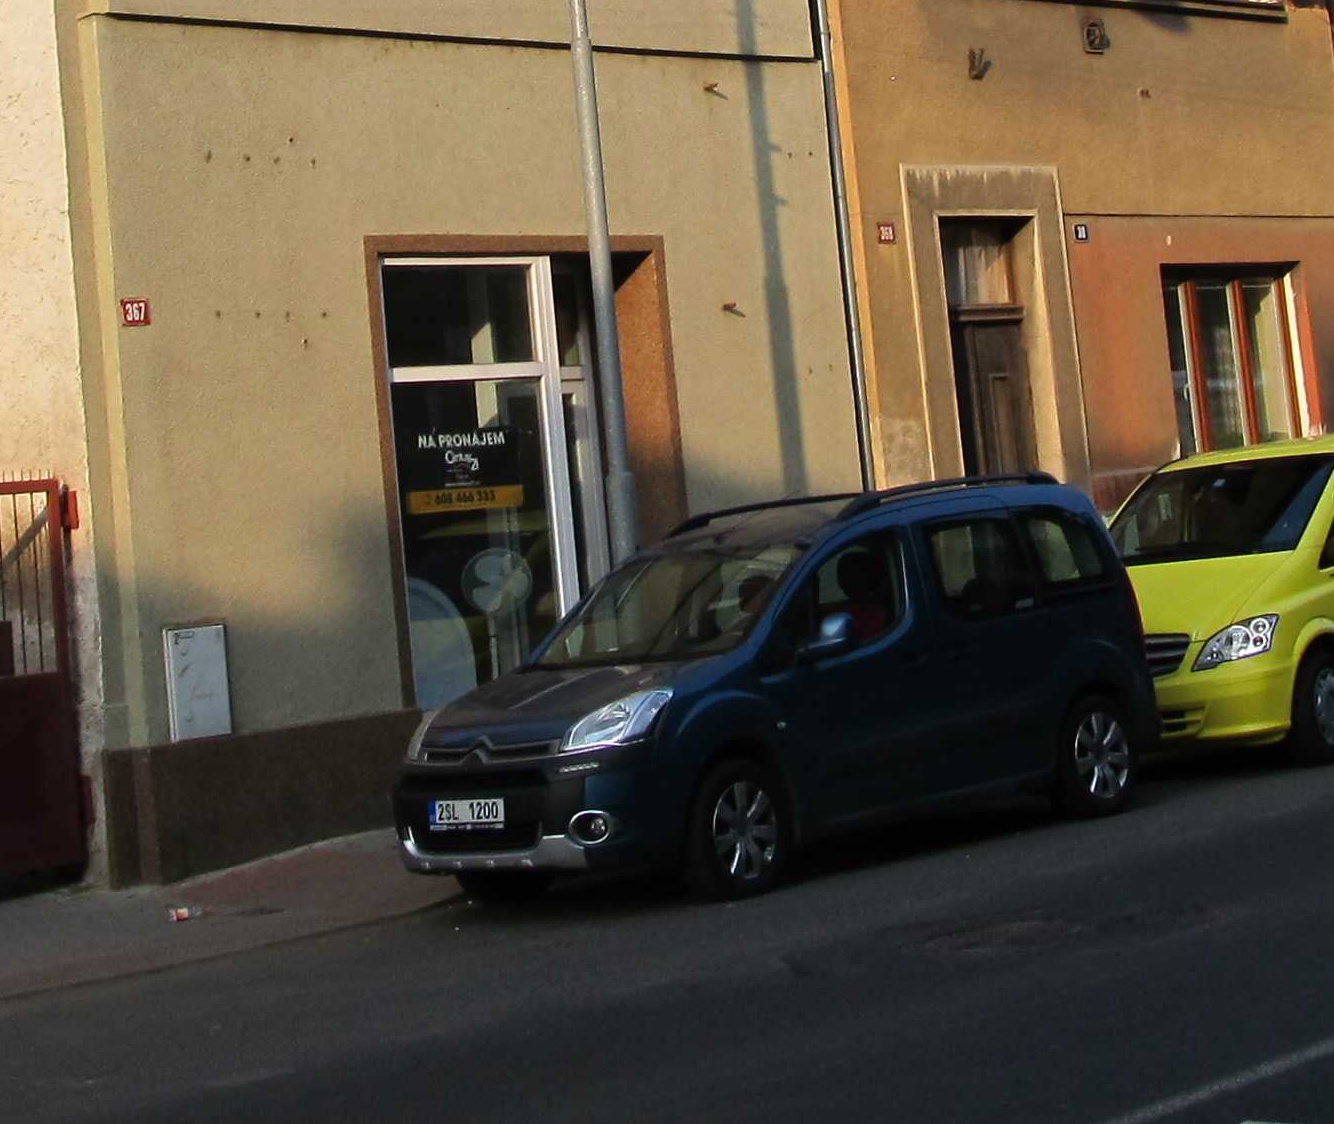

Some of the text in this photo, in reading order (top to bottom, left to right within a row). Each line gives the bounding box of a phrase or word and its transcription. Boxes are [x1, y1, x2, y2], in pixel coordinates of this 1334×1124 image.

[126, 303, 145, 321] 367
[418, 435, 436, 448] NA
[438, 801, 498, 821] 2SL 1200
